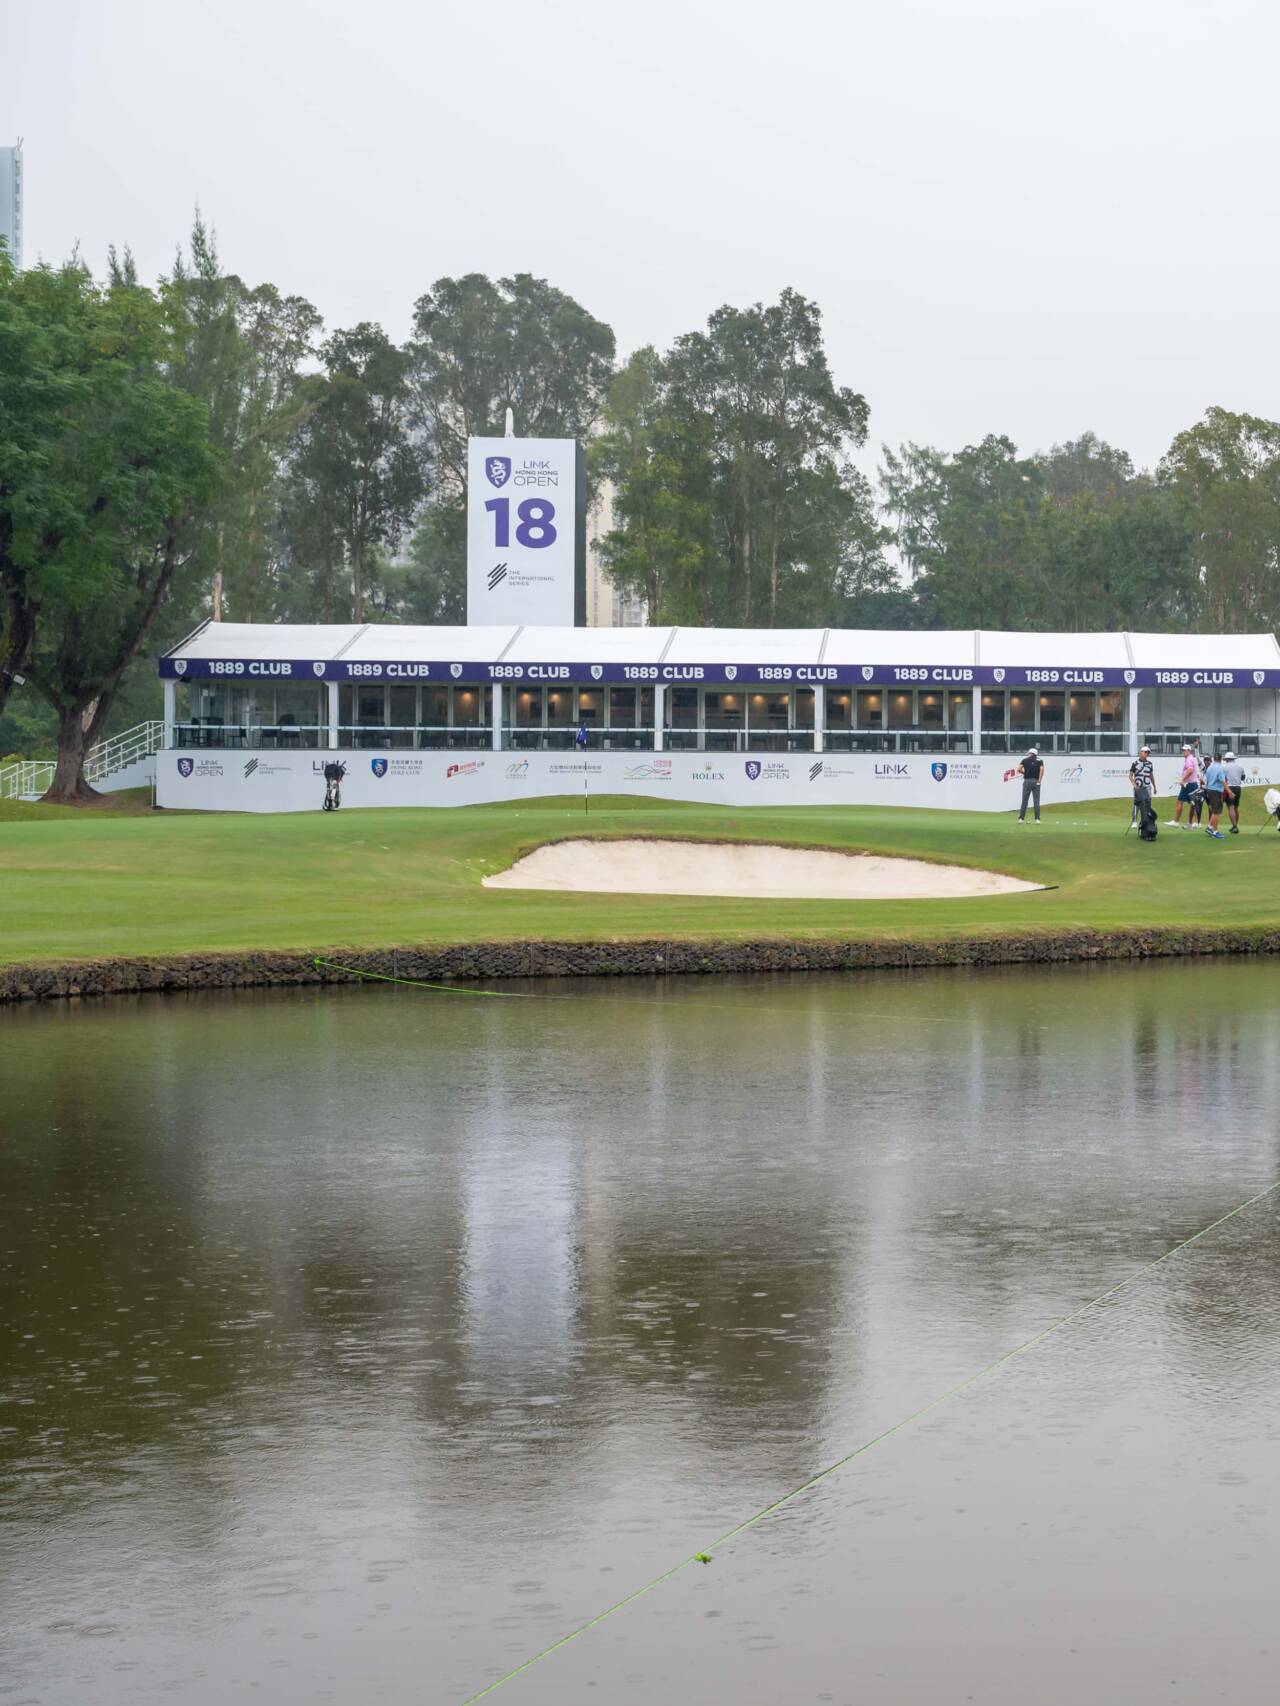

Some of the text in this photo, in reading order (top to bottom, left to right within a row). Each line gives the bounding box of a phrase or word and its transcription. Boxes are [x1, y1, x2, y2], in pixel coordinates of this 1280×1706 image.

[523, 460, 550, 469] LINK
[513, 476, 559, 487] OPEN
[484, 497, 557, 548] 18
[209, 663, 291, 674] 1889 CLUB
[347, 664, 429, 676] 1889 CLUB
[489, 666, 569, 677] 1889 CLUB
[624, 667, 704, 678] 1889 CLUB
[758, 668, 837, 679] 1889 CLUB
[894, 669, 973, 680] 1889 CLUB
[1026, 671, 1103, 682] 1889 CLUB
[1156, 672, 1233, 683] 1889 CLUB
[875, 764, 908, 774] LINK
